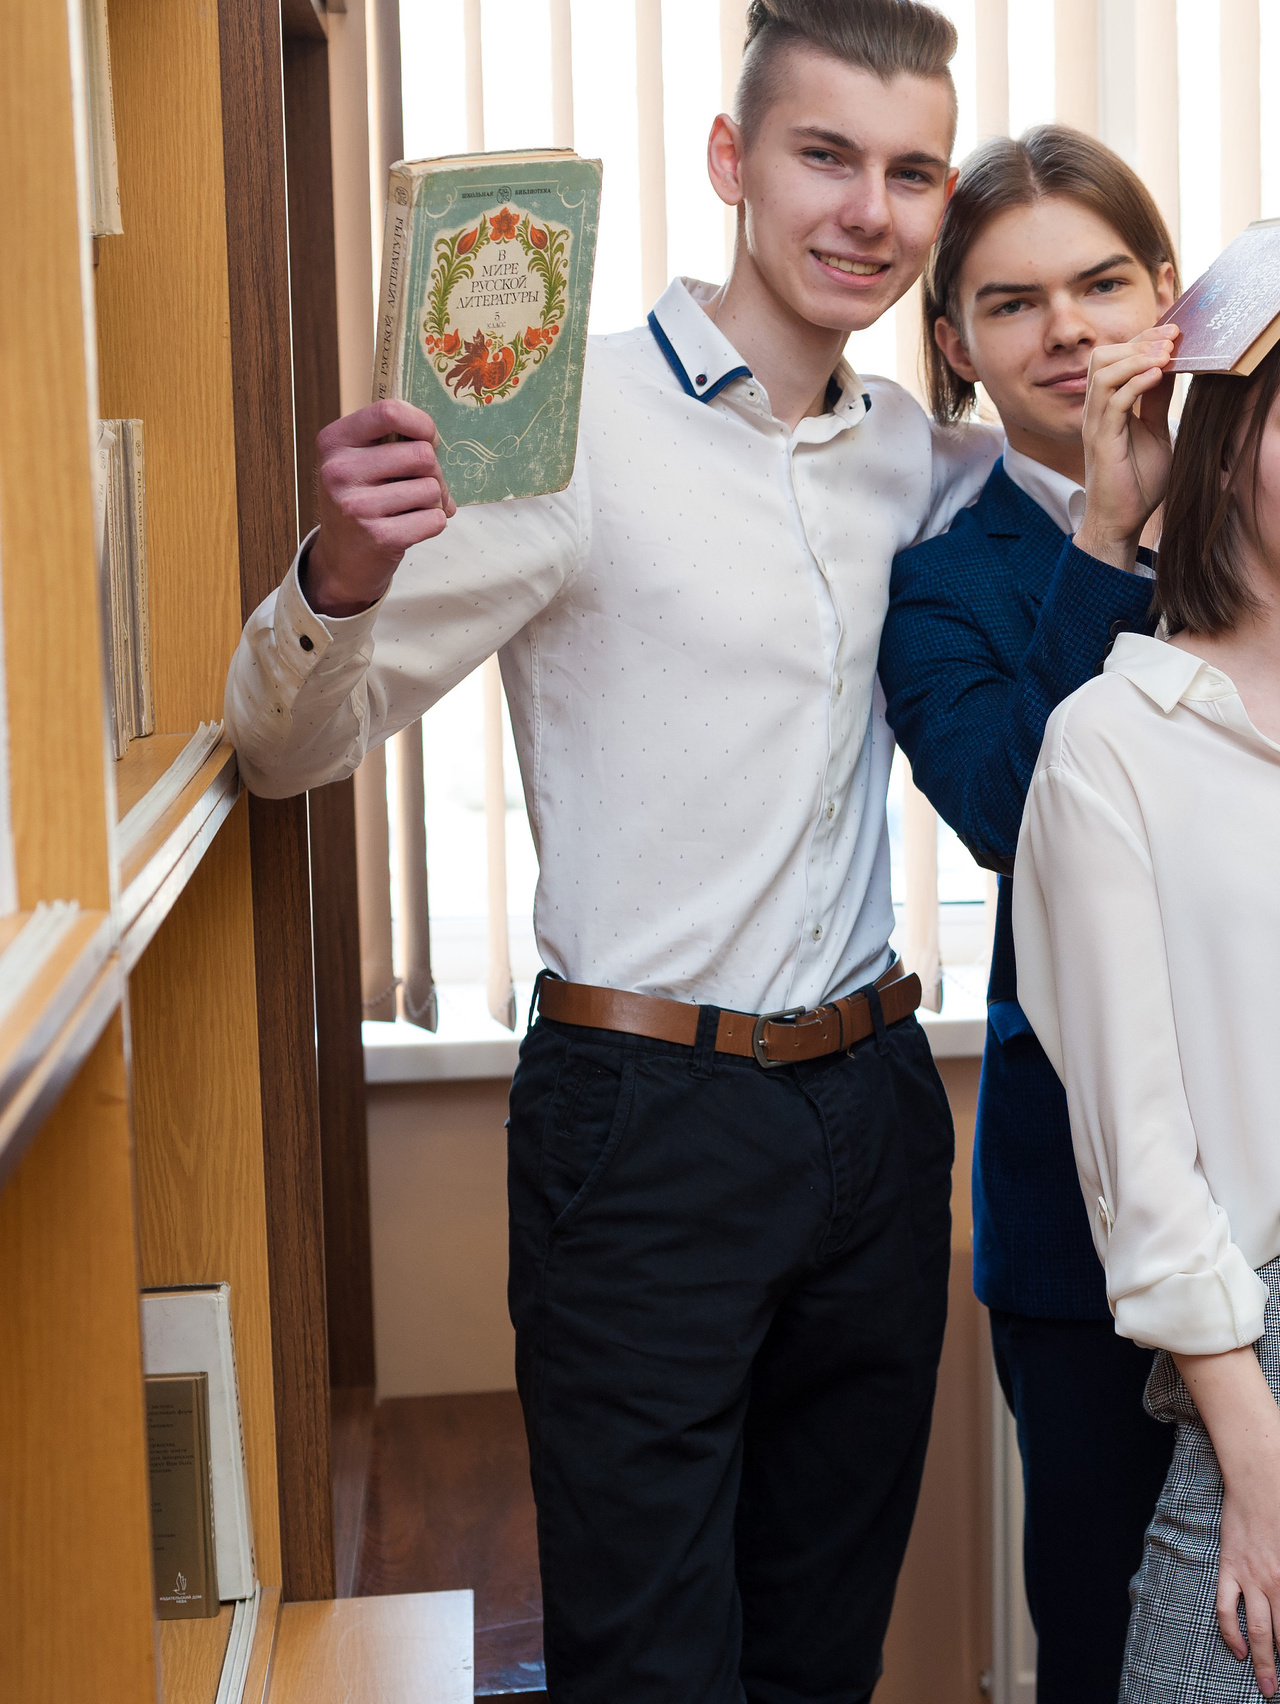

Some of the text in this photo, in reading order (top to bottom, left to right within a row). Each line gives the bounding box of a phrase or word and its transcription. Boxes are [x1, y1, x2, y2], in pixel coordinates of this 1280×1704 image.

[461, 188, 551, 199] ШКОЛЬНАЯ БИБЛИОТЕКА
[387, 216, 404, 309] ЛИТЕРАТУРЫ
[498, 250, 507, 262] В
[482, 262, 520, 277] МИРЕ
[471, 275, 528, 293] РУССКОЙ
[456, 291, 540, 309] ЛИТЕРАТУРЫ
[494, 311, 500, 321] 5
[381, 315, 394, 376] РУССКОЙ
